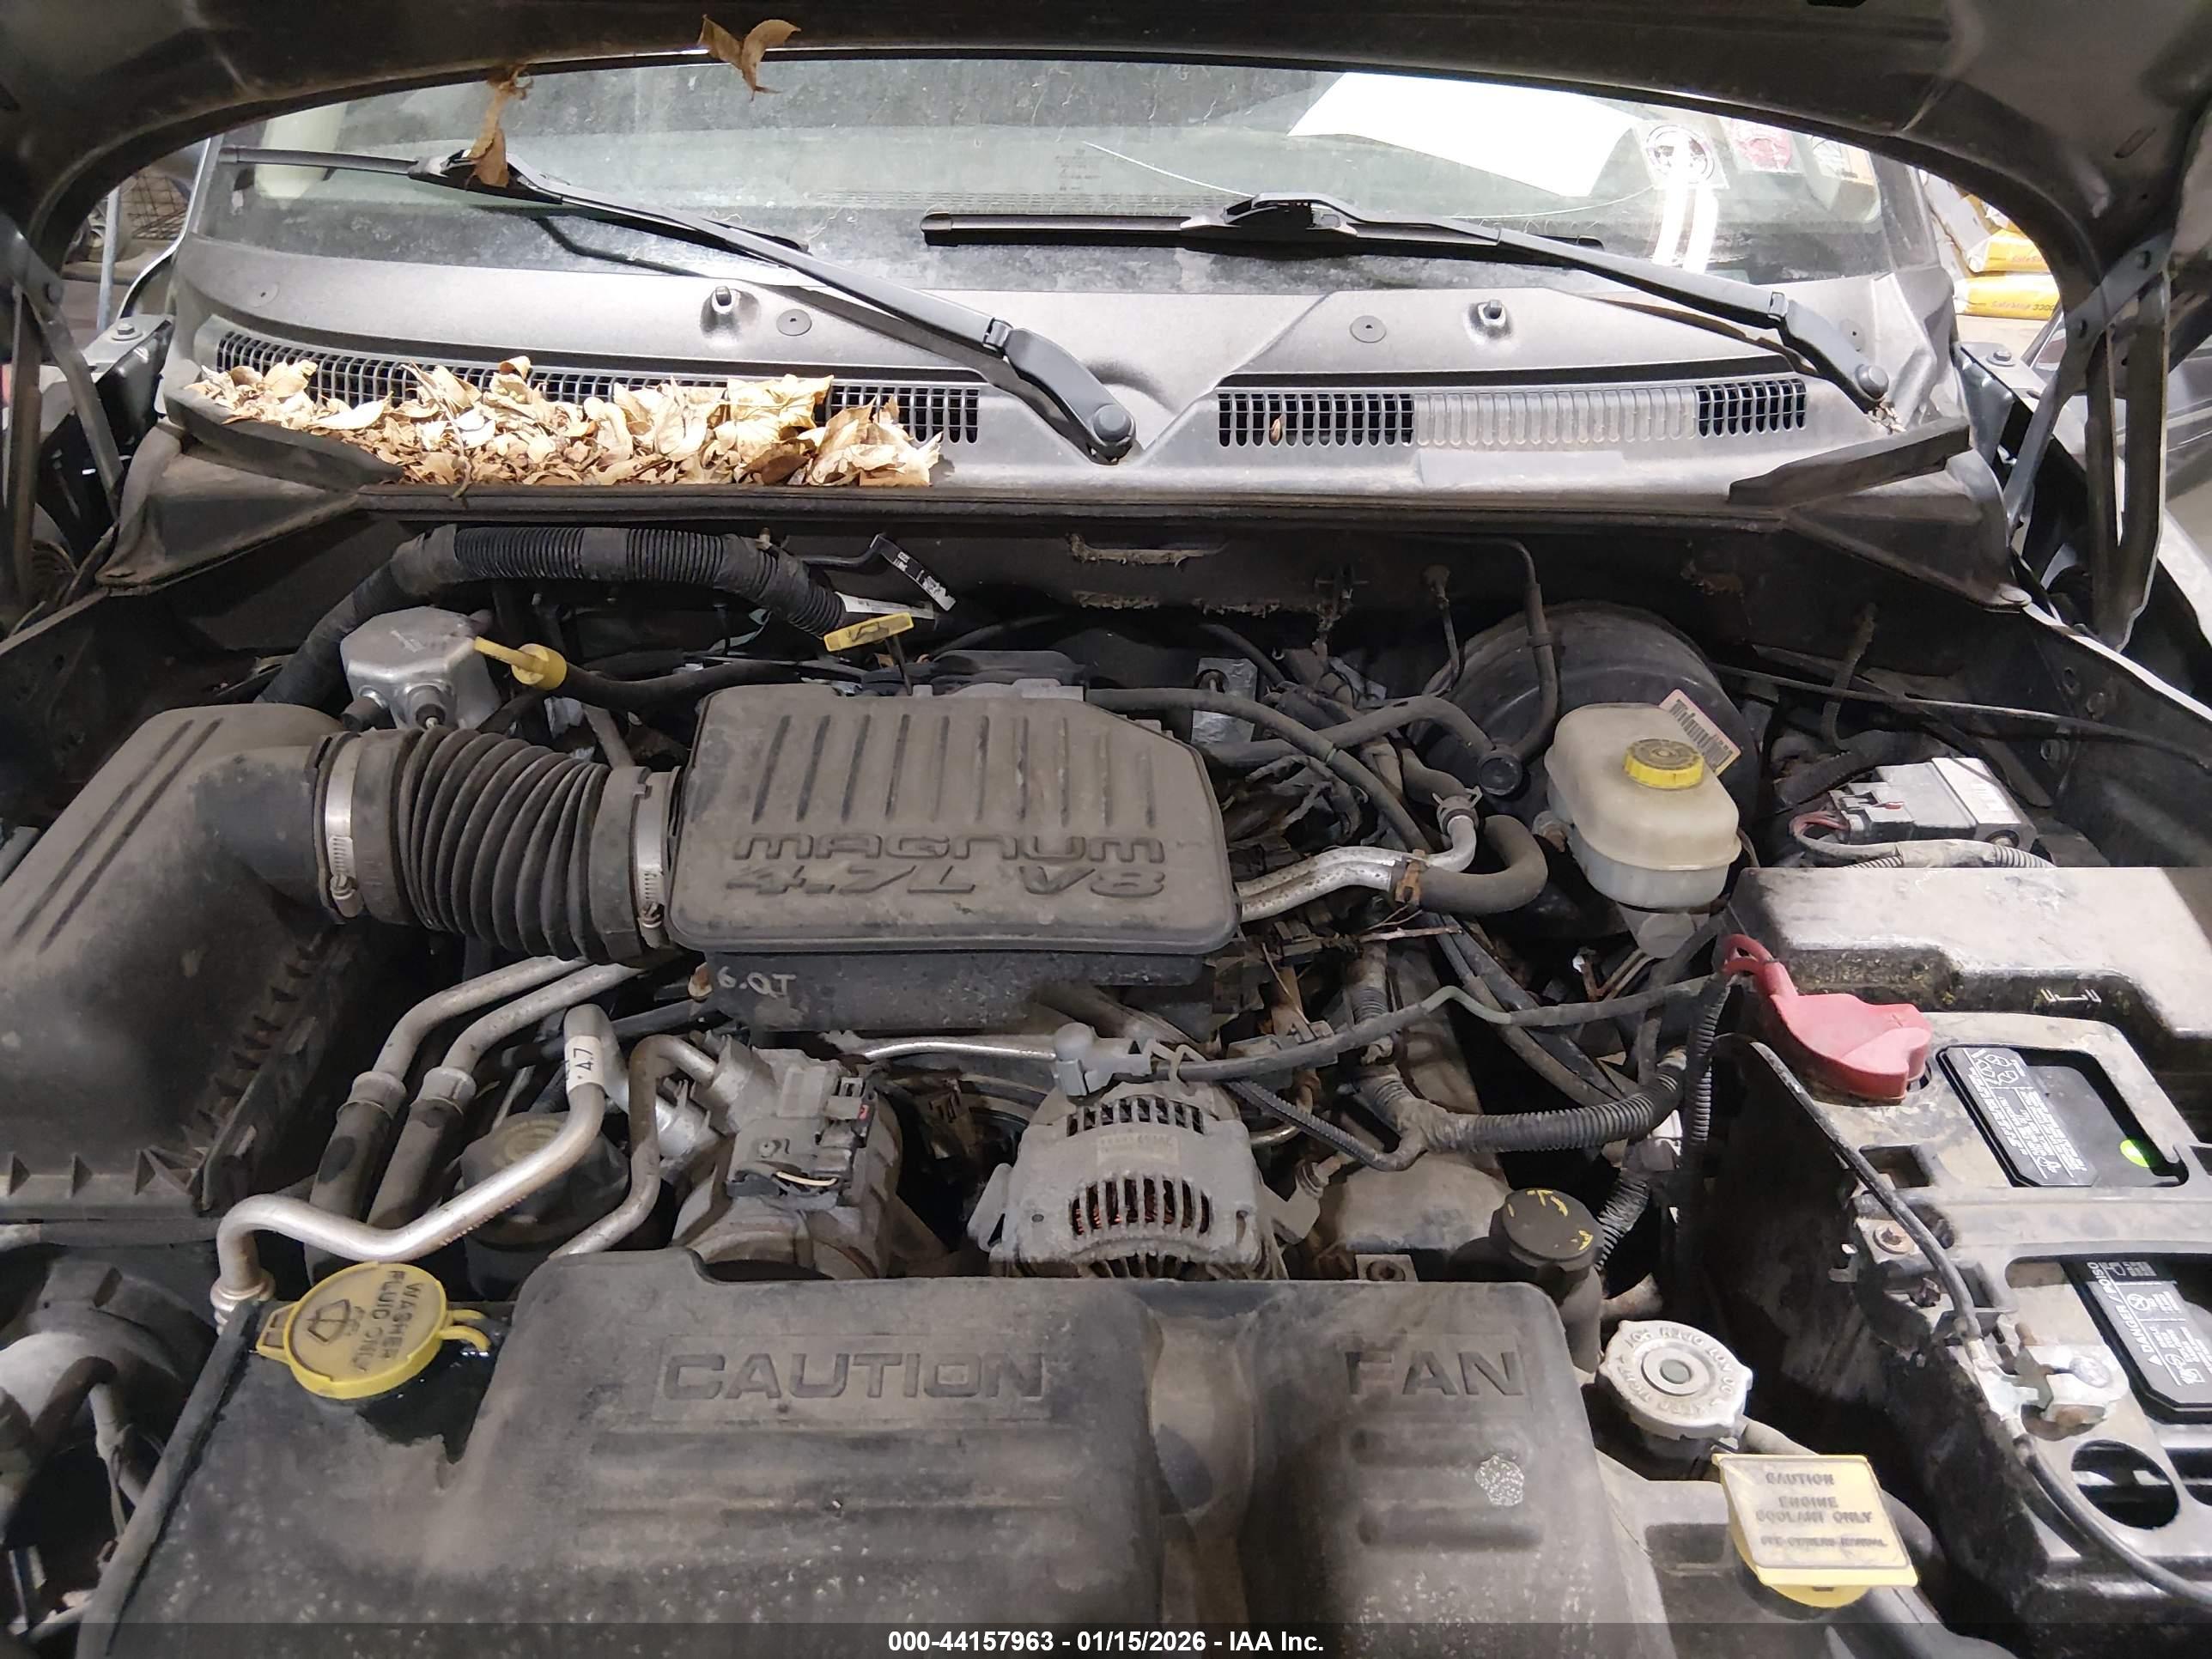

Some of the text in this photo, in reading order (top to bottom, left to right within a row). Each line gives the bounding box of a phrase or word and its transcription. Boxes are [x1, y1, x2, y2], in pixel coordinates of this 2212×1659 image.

[734, 833, 1165, 864] MAGNUM
[726, 862, 1165, 898] 4.7L V8
[350, 1269, 406, 1372] FLUID ONLY
[379, 1282, 424, 1359] WASHER
[2115, 1304, 2155, 1353] DANGER
[664, 1350, 1525, 1401] CAUTION FAN
[1765, 1472, 1835, 1486] CAUTION
[1755, 1510, 1873, 1524] COOLANT ONLY
[1778, 1496, 1839, 1510] ENGINE
